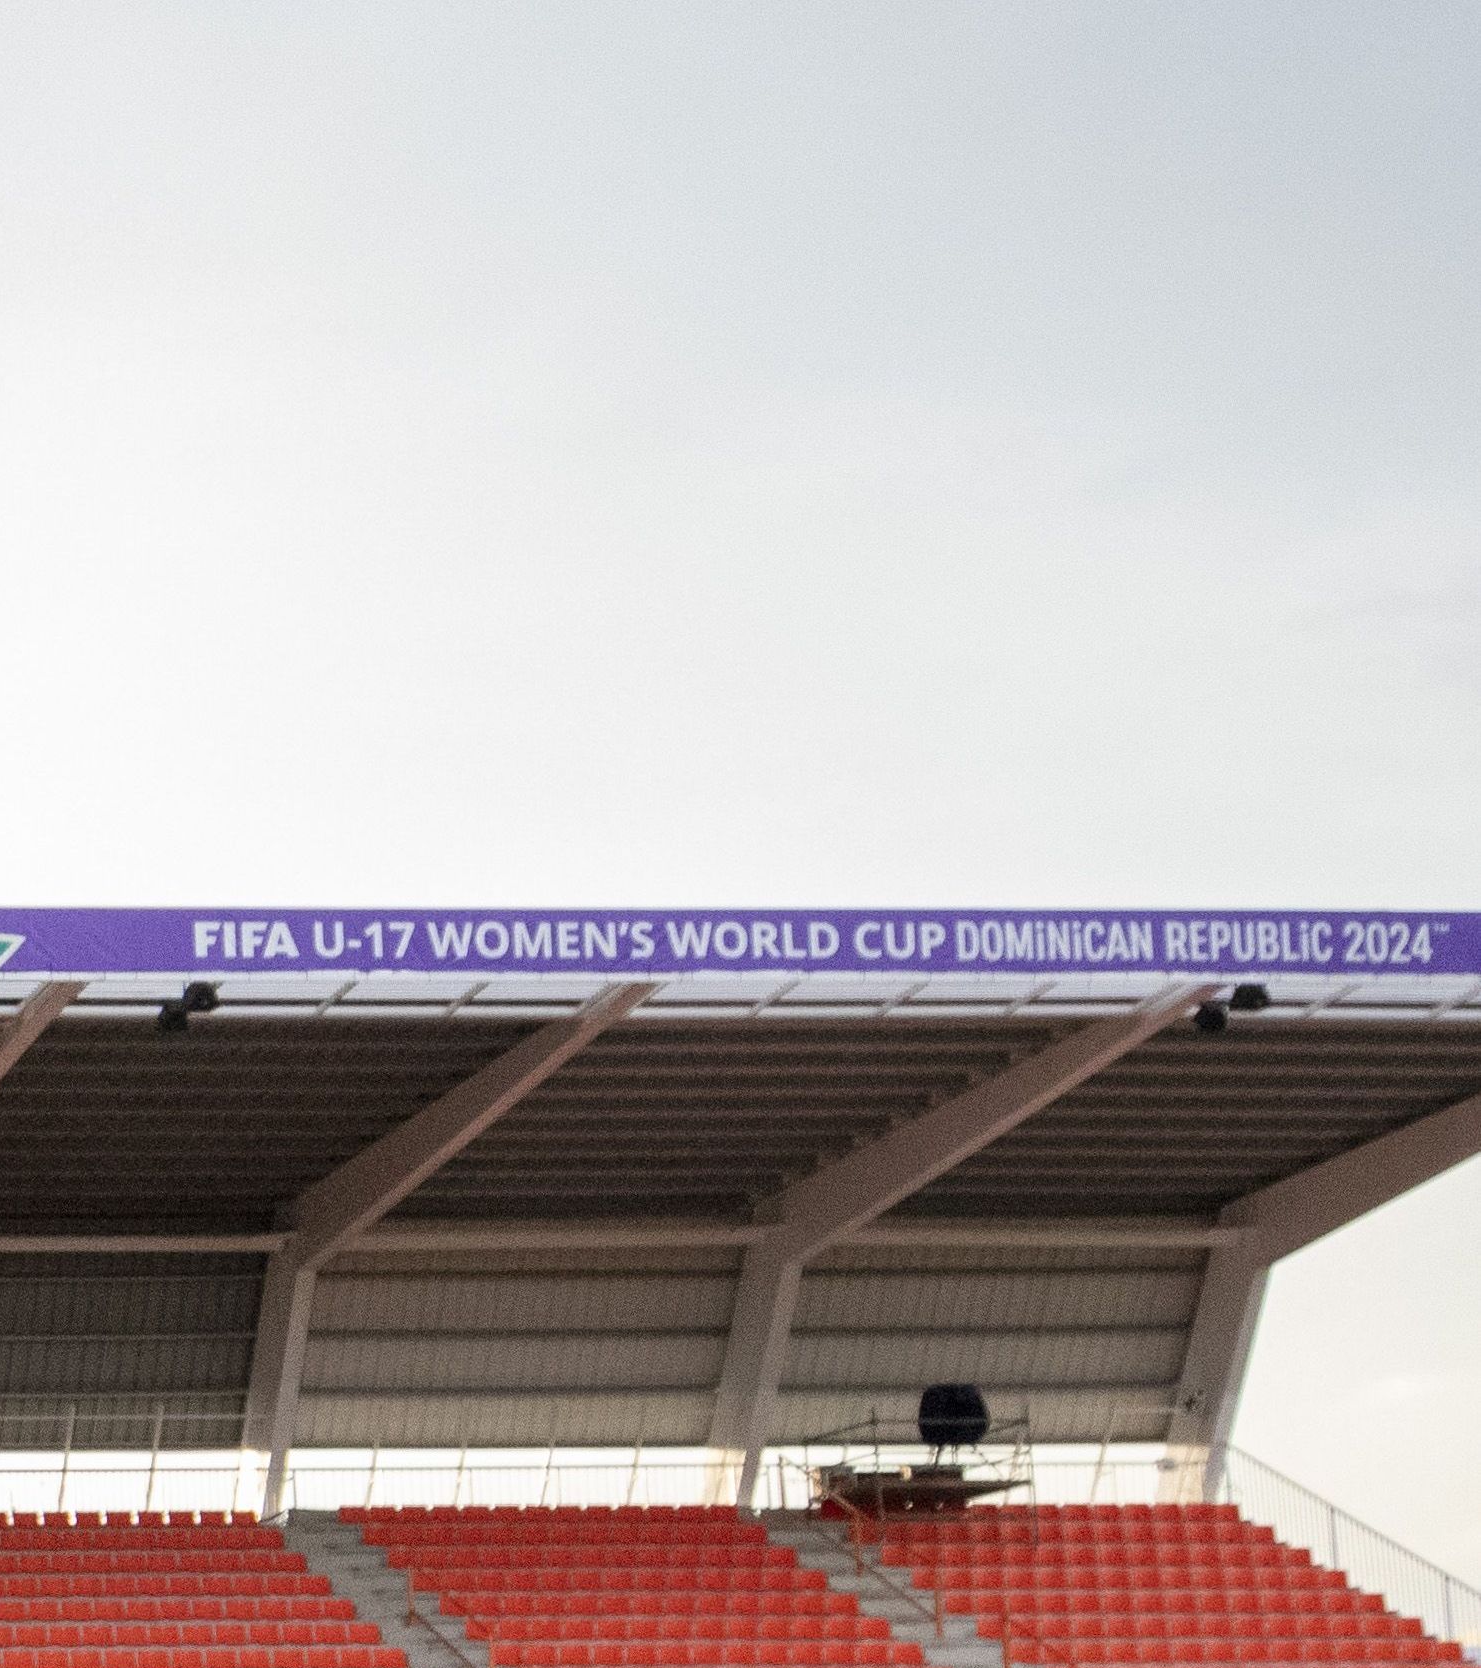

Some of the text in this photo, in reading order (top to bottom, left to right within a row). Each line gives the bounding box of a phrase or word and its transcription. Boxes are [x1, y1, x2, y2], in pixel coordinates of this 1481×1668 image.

[193, 920, 301, 960] FIFA
[313, 920, 416, 960] U-17
[427, 920, 656, 960] WOMEN’S
[664, 920, 841, 960] WORLD
[854, 920, 947, 960] CUP
